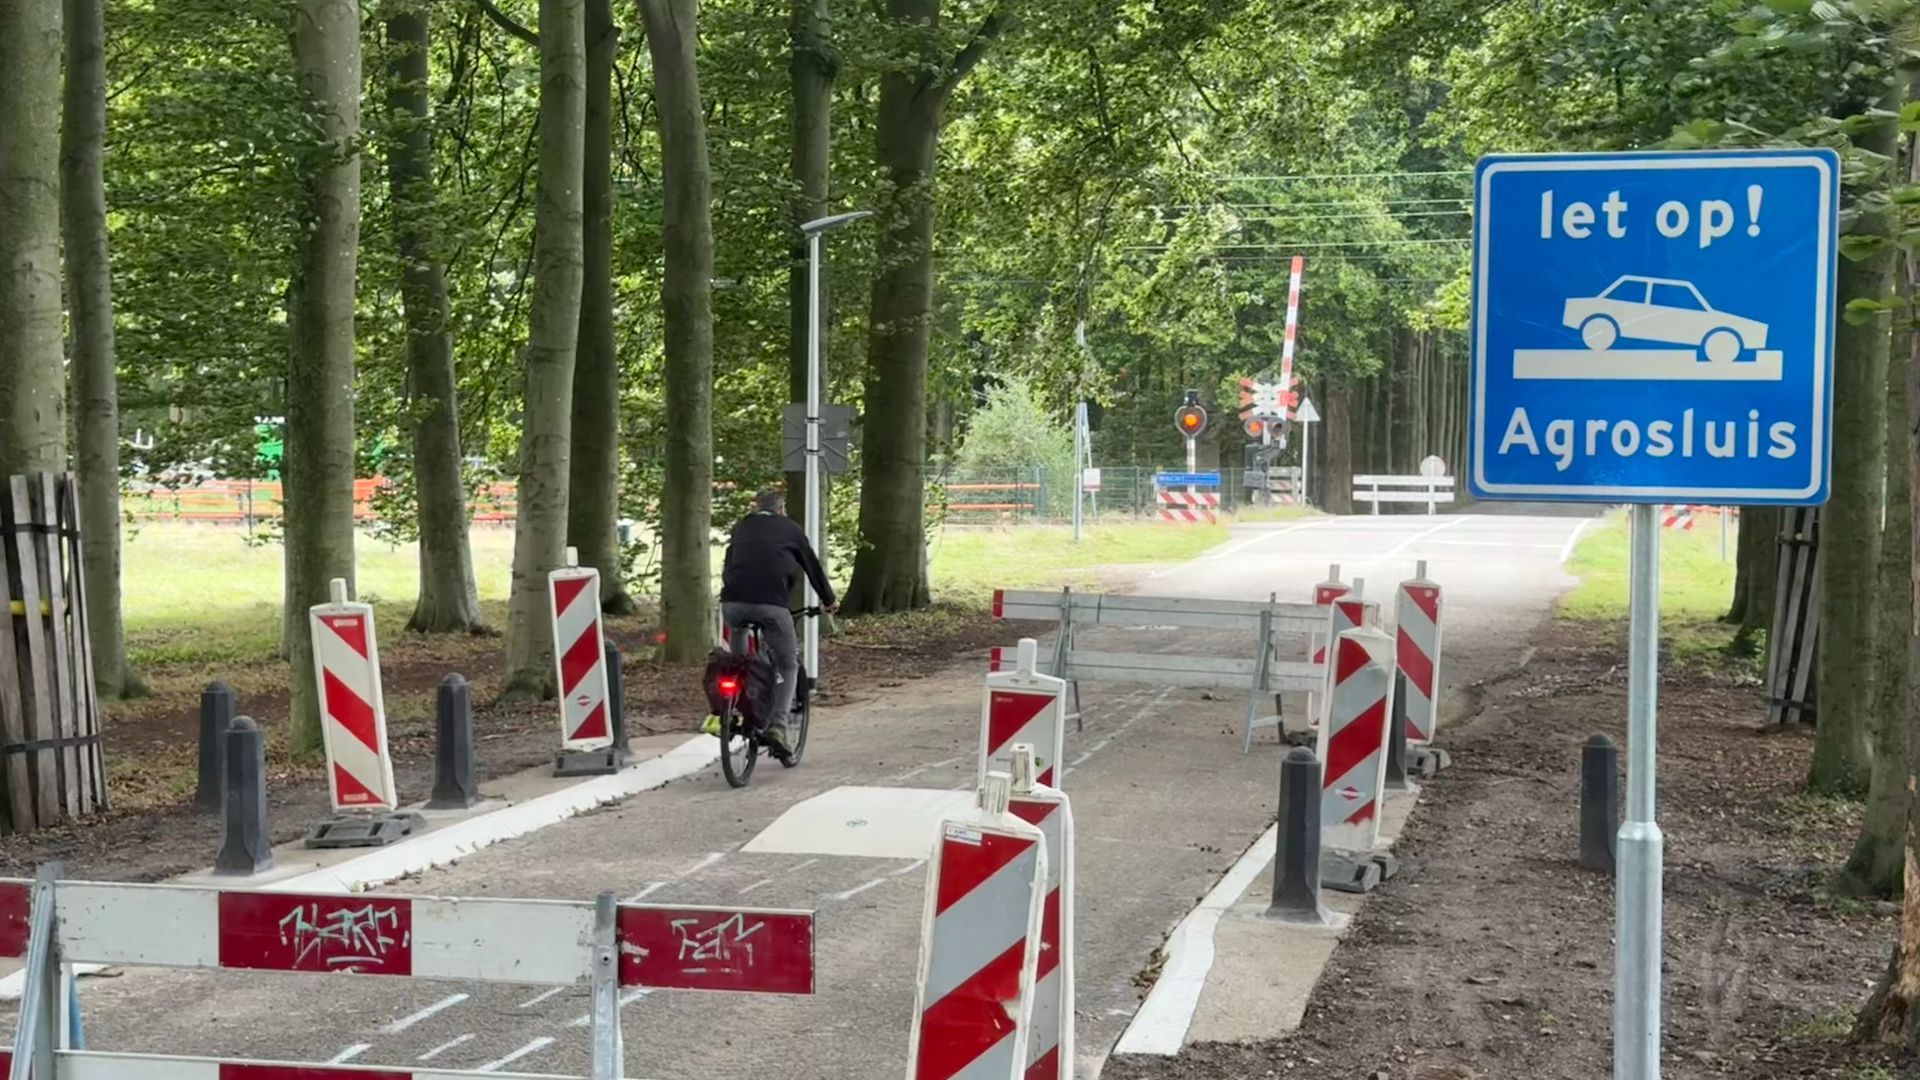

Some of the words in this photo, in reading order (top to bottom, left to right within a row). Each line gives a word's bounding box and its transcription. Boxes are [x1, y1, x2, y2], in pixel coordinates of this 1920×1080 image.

[1540, 189, 1628, 239] let
[1656, 184, 1764, 249] op!
[1498, 407, 1797, 472] Agrosluis
